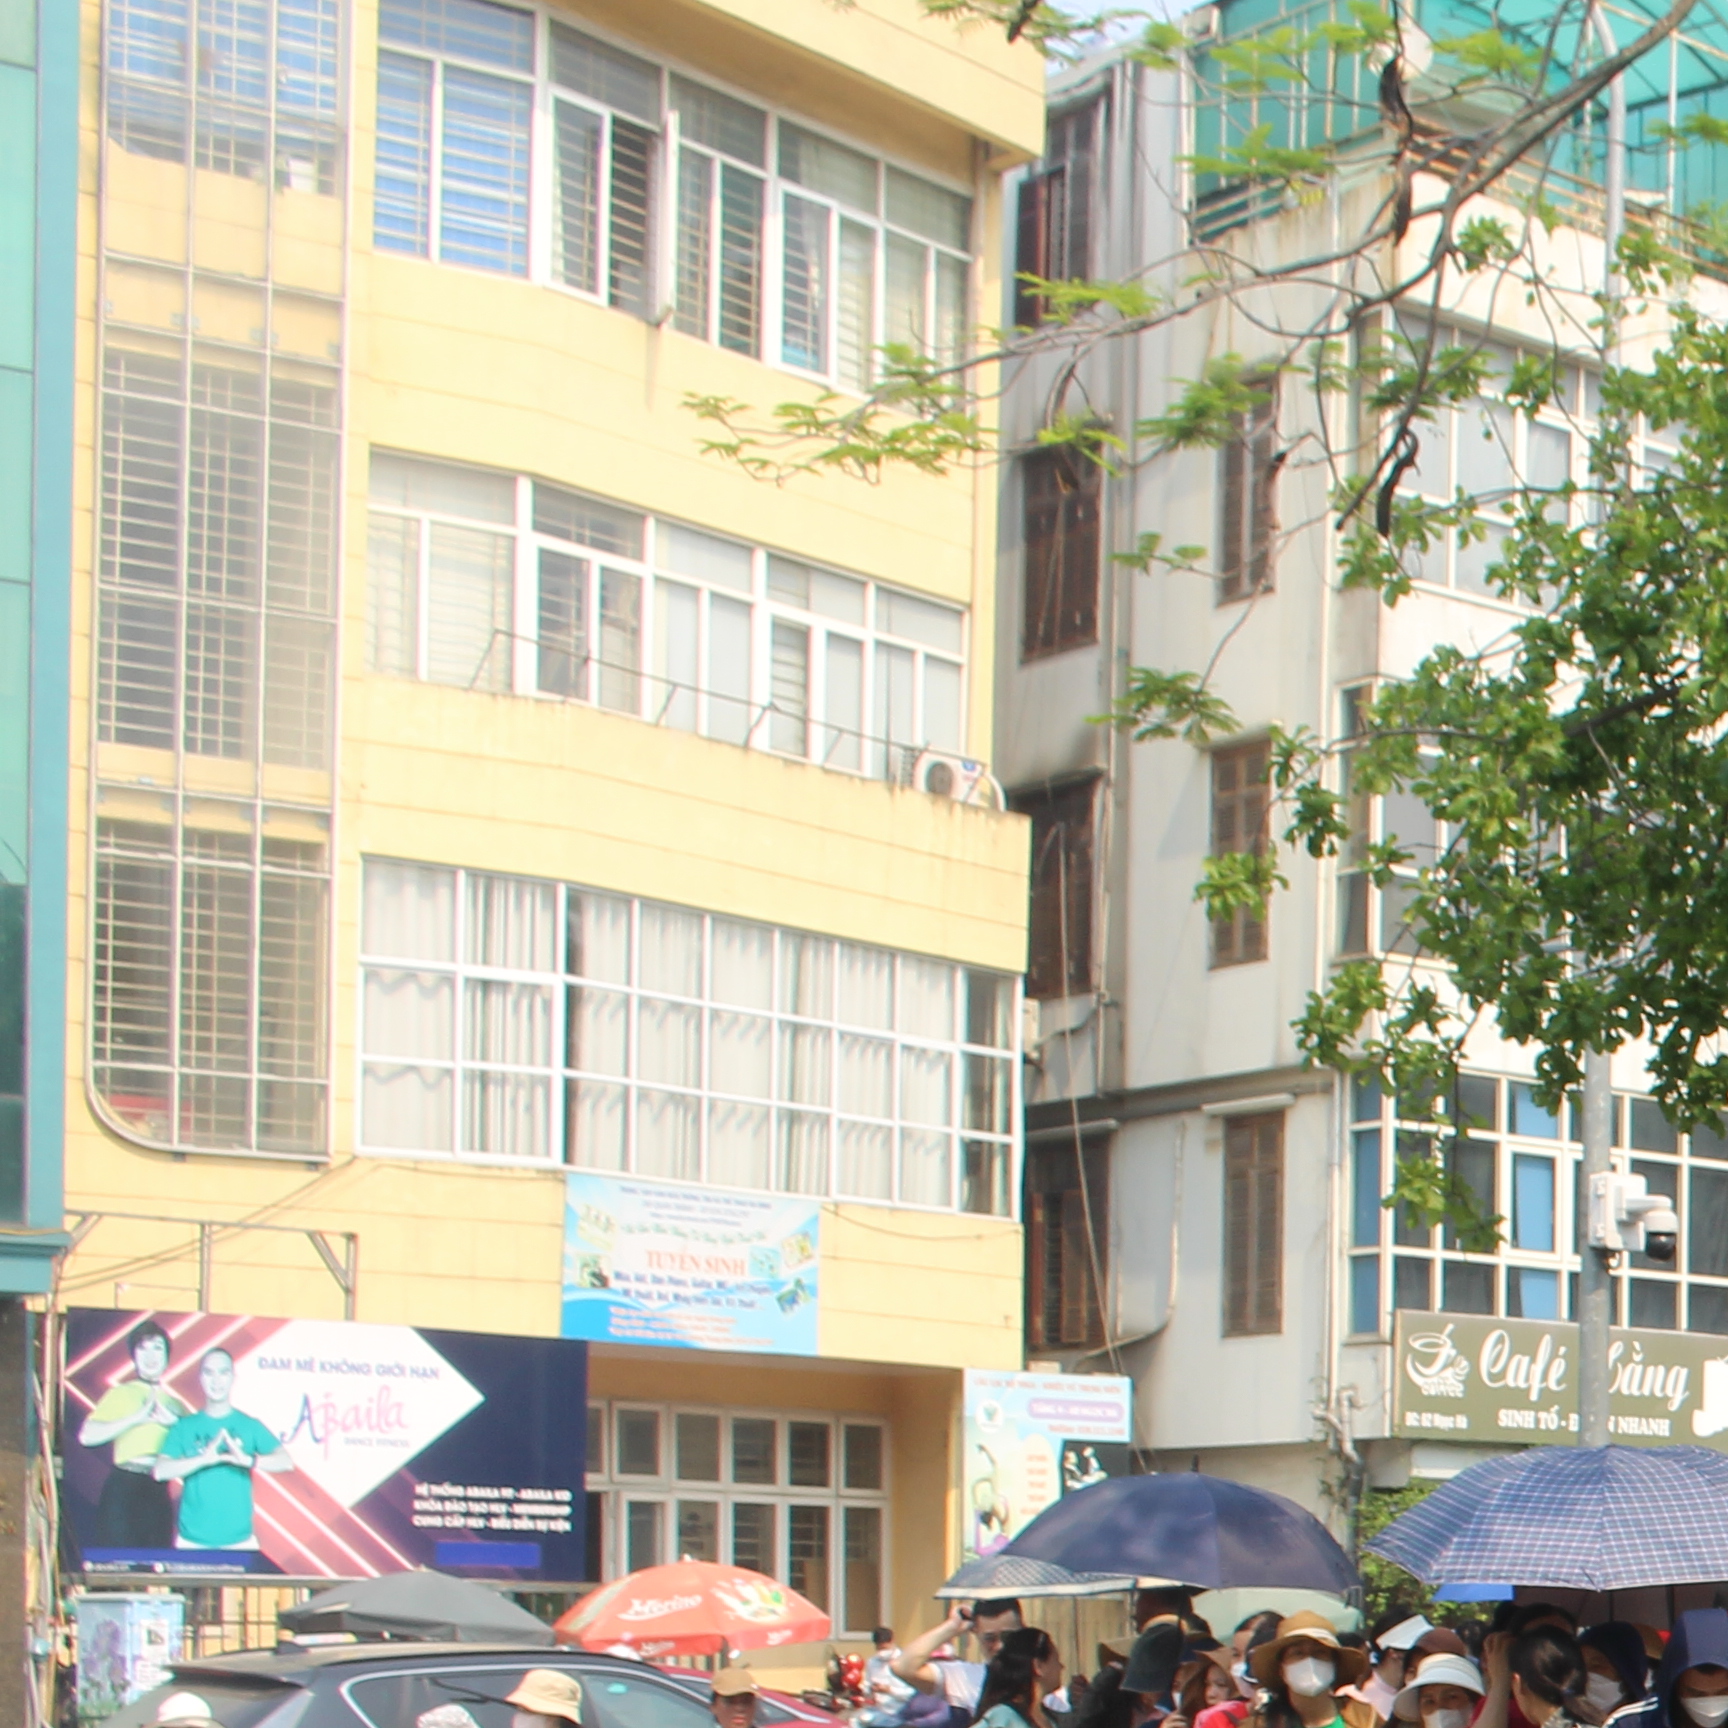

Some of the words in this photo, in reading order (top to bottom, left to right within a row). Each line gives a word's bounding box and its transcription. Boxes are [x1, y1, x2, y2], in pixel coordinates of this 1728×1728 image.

[704, 1256, 747, 1277] SINH
[319, 1357, 371, 1377] KHÔNG
[1479, 1329, 1567, 1401] Café
[1497, 1408, 1535, 1429] SINH
[1537, 1404, 1560, 1431] TỐ
[1618, 1416, 1671, 1437] NHANH
